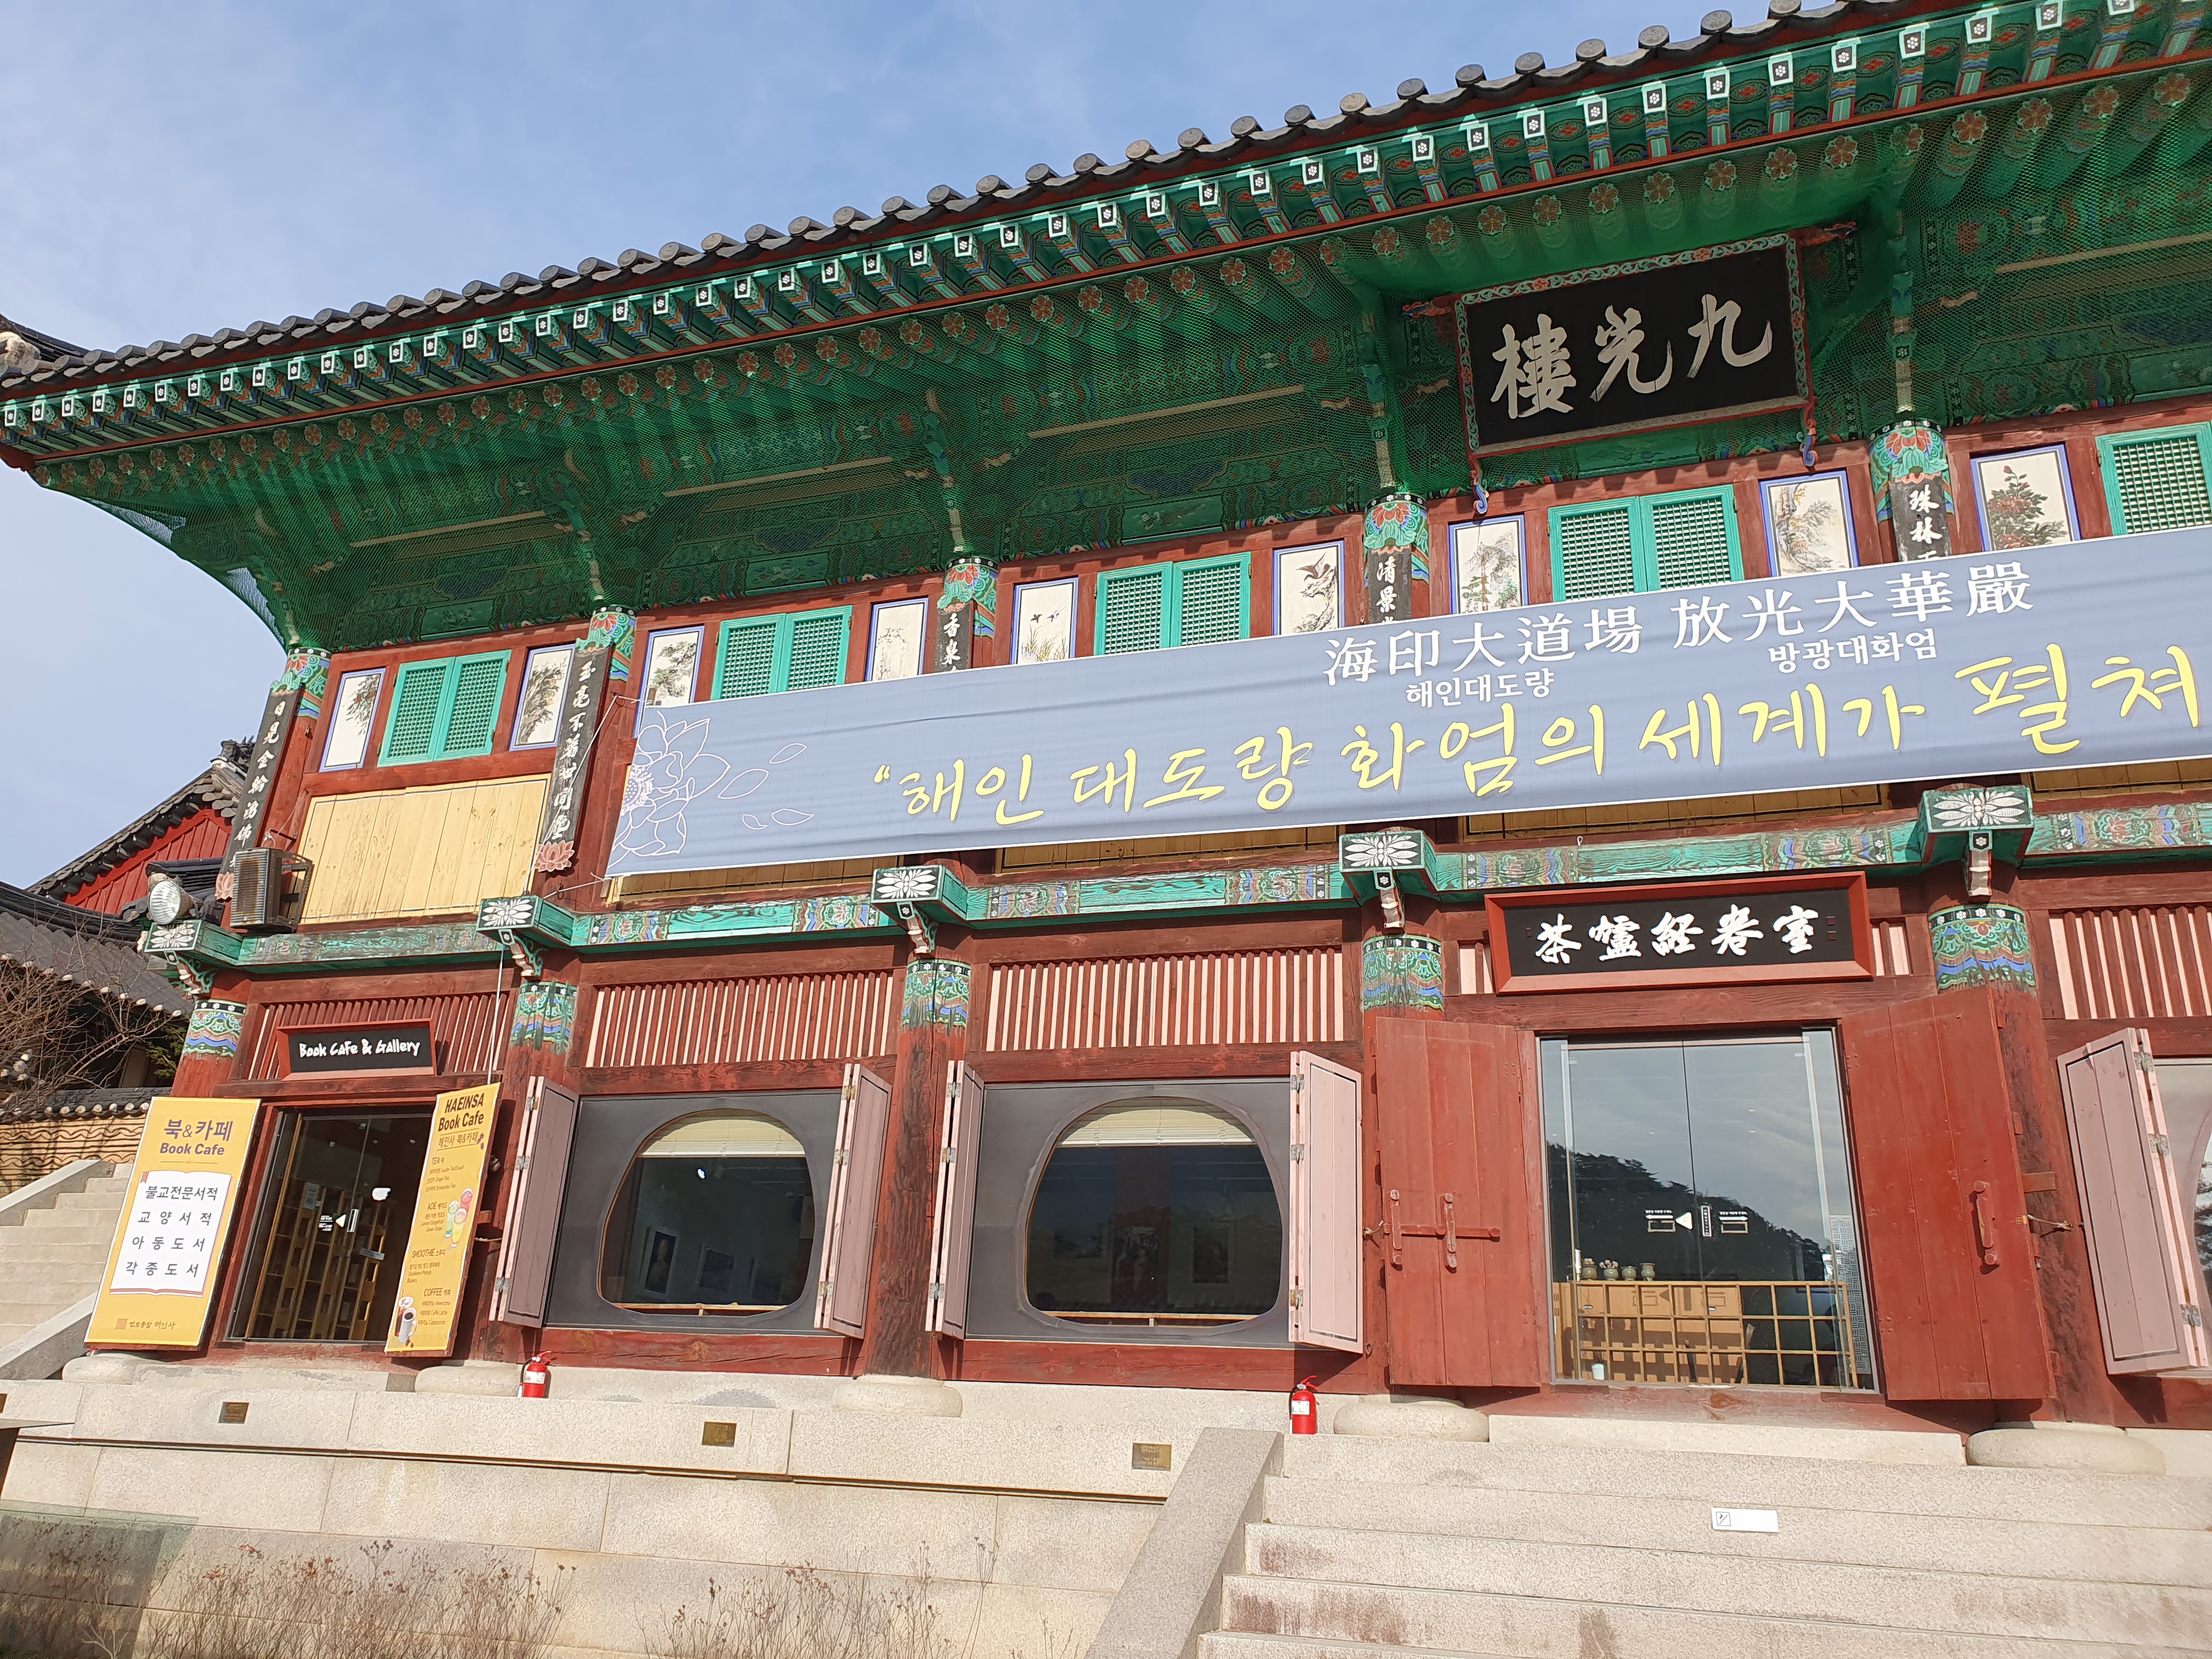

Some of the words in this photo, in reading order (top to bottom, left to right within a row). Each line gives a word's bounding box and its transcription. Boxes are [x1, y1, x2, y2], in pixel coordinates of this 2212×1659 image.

[1322, 605, 1644, 687] 海印大道場
[1670, 561, 2034, 649] 放光大華嚴
[1405, 667, 1555, 709] 해인대도량
[1768, 627, 1938, 674] 방광대화엄
[1340, 702, 1605, 797] 화엄의
[1638, 682, 1926, 768] 세계가
[1954, 643, 2199, 754] 펼쳐
[299, 1042, 327, 1058] Book
[329, 1040, 358, 1056] Cafe
[361, 1038, 372, 1055] &
[375, 1039, 420, 1057] Gallery
[444, 1092, 485, 1114] HAEINSA
[163, 1119, 234, 1142] 북&카페
[438, 1114, 461, 1132] Book
[462, 1110, 484, 1127] Cafe
[159, 1142, 193, 1154] Book
[194, 1143, 225, 1155] Cafe
[438, 1135, 455, 1148] 해인사
[431, 1156, 440, 1165] TEA
[145, 1186, 218, 1201] 불교전문서적
[427, 1201, 437, 1210] ADE
[424, 1288, 443, 1296] COFFEE
